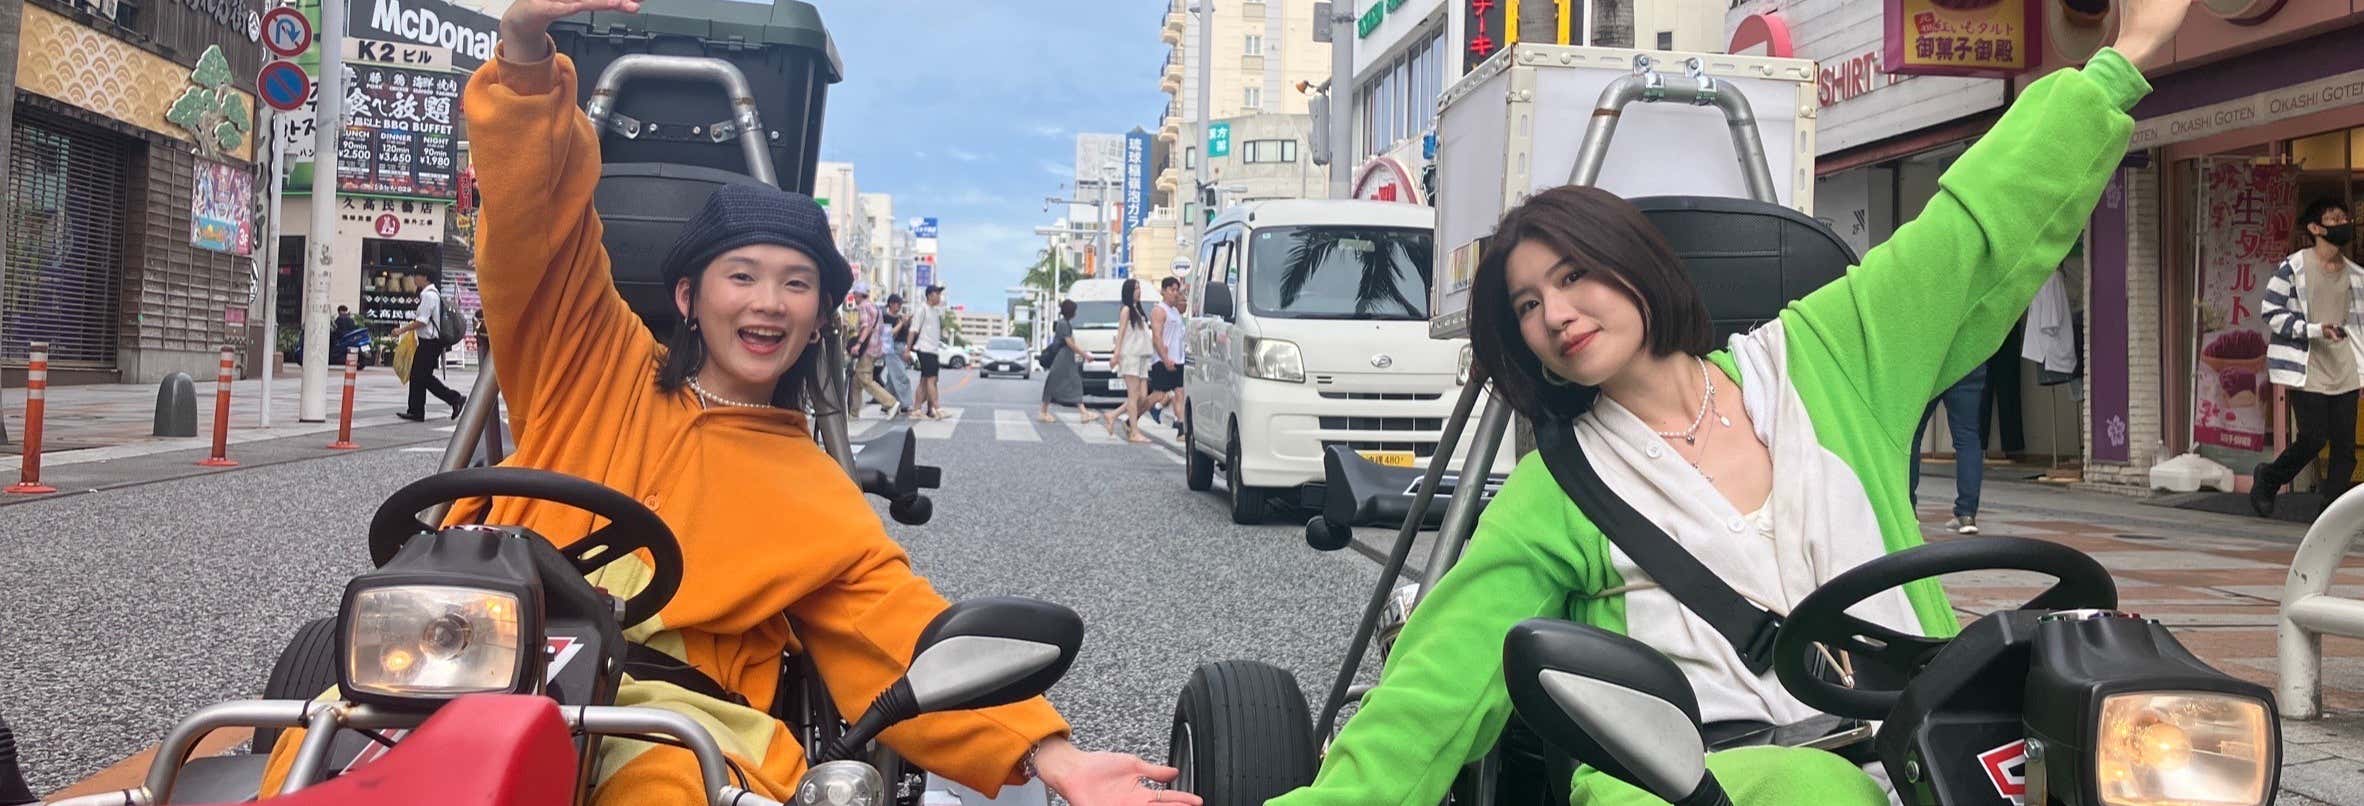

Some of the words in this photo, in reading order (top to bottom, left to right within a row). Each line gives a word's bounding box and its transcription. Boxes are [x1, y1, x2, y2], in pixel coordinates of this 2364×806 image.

[371, 0, 497, 60] McDonal
[358, 40, 395, 63] K2
[404, 49, 432, 65] ビル
[1916, 36, 2013, 62] 御菓子御殿
[346, 87, 451, 124] 食べ放題
[2270, 91, 2318, 114] OKASHI
[383, 119, 409, 131] BBQ
[412, 122, 453, 134] BUFFET
[2170, 115, 2212, 136] OKASHI
[2214, 105, 2256, 126] GOTEN
[381, 132, 412, 143] DINNER
[423, 136, 449, 145] NIGHT
[2131, 127, 2160, 144] OTEN
[343, 140, 367, 150] 90min
[382, 143, 409, 154] 120min
[423, 147, 447, 157] 90min
[338, 150, 371, 160] ¥2,500
[379, 152, 412, 163] ¥3,650
[420, 155, 450, 166] ¥1,980
[1127, 137, 1143, 236] 琉球稲嶺泡ガラ
[2230, 187, 2265, 325] 生タルト
